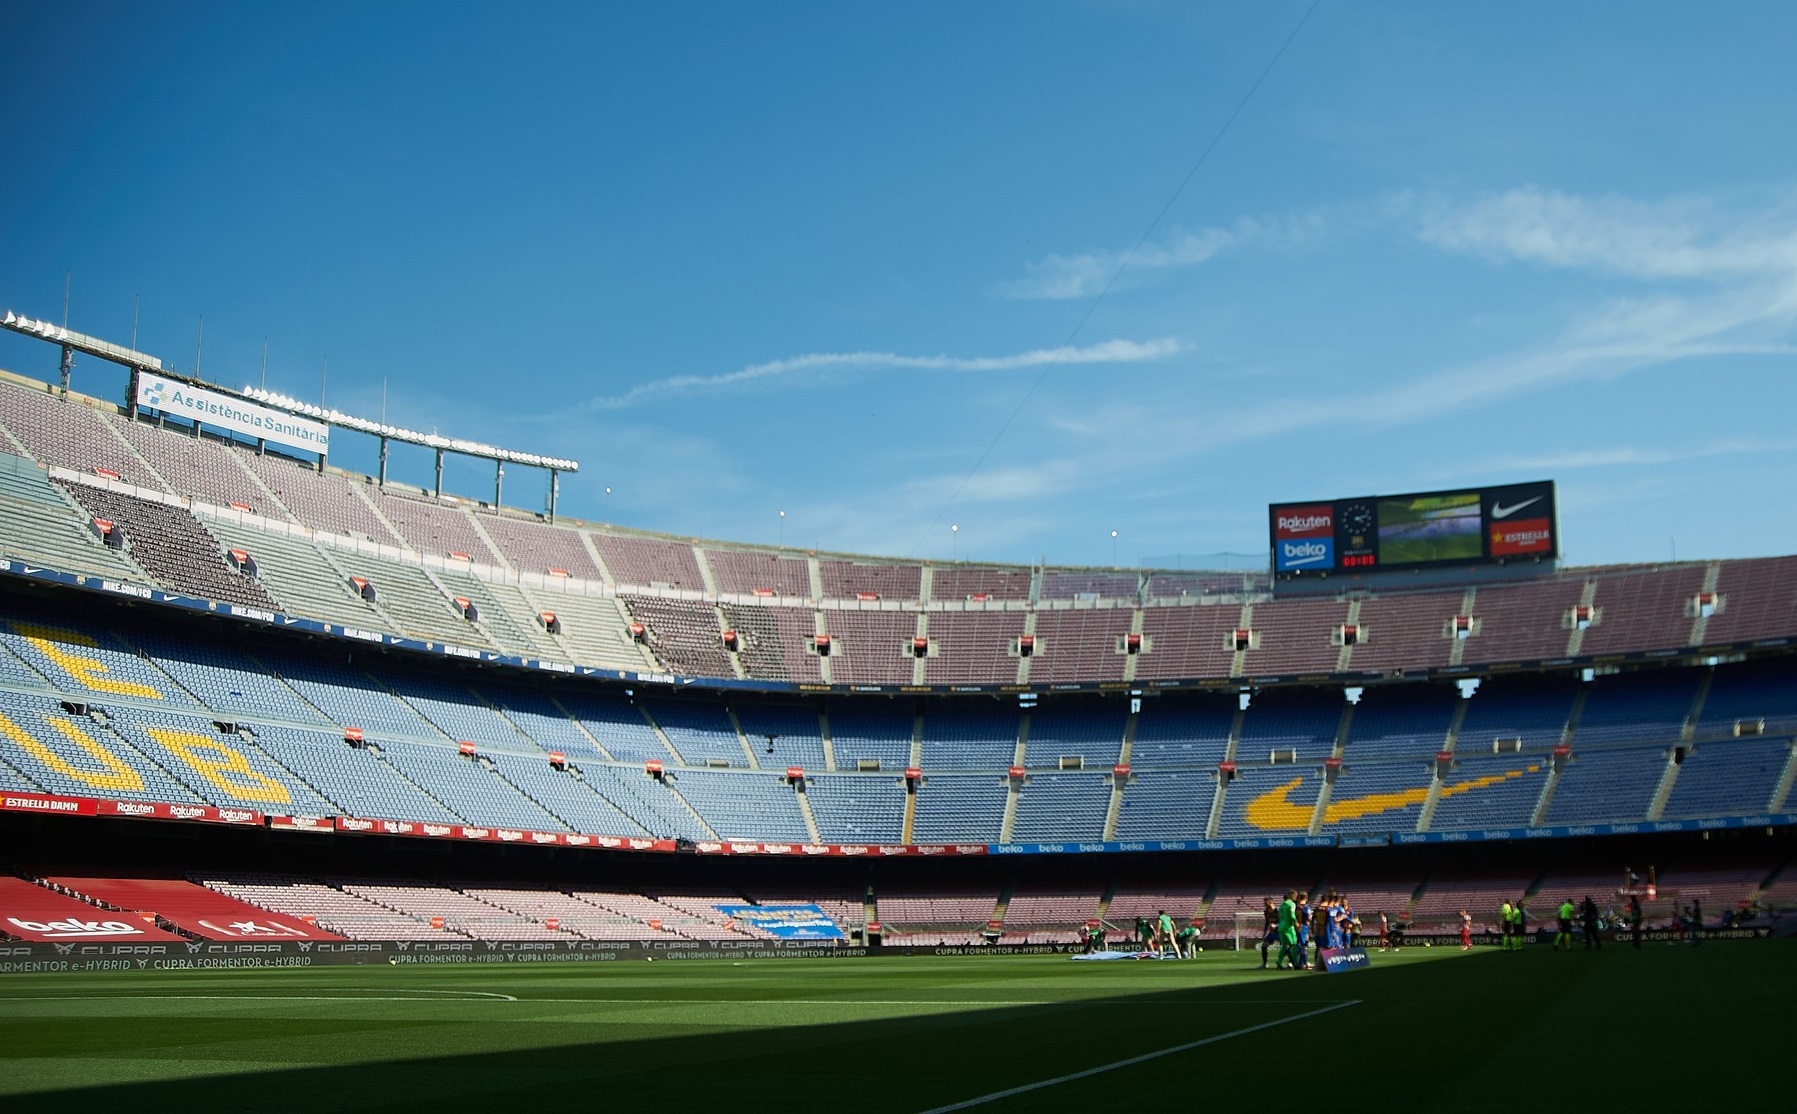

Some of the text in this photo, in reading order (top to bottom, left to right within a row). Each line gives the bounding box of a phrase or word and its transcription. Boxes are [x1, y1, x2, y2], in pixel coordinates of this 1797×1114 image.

[172, 391, 262, 428] Assistència
[1278, 515, 1331, 531] Rakuten
[1284, 542, 1326, 557] beko
[1343, 555, 1375, 567] 00:00
[6, 797, 79, 812] ESTRELLA DAMM
[117, 802, 155, 814] Rakuten
[170, 805, 206, 818] Rakuten
[219, 809, 253, 820] Rakuten
[342, 818, 373, 829] Rakuten
[1699, 820, 1727, 829] beko
[1743, 816, 1771, 826] beko
[384, 820, 413, 832] Rakten
[423, 824, 451, 835] Rakuten
[1569, 826, 1595, 835] beko
[1611, 824, 1639, 833] beko
[1655, 822, 1682, 831] beko
[462, 827, 489, 838] Rakuten
[1442, 832, 1468, 841] beko
[1484, 830, 1510, 839] beko
[1526, 828, 1552, 837] beko
[1268, 838, 1294, 847] beko
[1305, 837, 1331, 846] beko
[1400, 834, 1426, 842] beko
[1038, 844, 1064, 852] beko
[1079, 843, 1104, 852] beko
[1120, 843, 1145, 851] beko
[1160, 842, 1186, 850] beko
[1198, 841, 1224, 849] beko
[1234, 840, 1259, 848] beko
[840, 846, 868, 855] Rakuten
[880, 846, 907, 855] Rakuten
[918, 846, 945, 854] Rakuten
[956, 846, 983, 854] Rakuten
[998, 845, 1023, 853] beko
[7, 918, 136, 933] beko
[81, 946, 167, 954] CUPRA
[208, 945, 282, 953] CUPRA
[318, 944, 382, 952] CUPRA
[414, 943, 473, 951] CUPRA
[1068, 945, 1095, 954] CUPA
[935, 948, 963, 956] CUPRA
[154, 957, 311, 969] CUPRA FORMENTOR e-HYBRID
[389, 954, 504, 964] CUPRA FORMENTOR e-HYBRID
[72, 960, 131, 970] e-HYBRID
